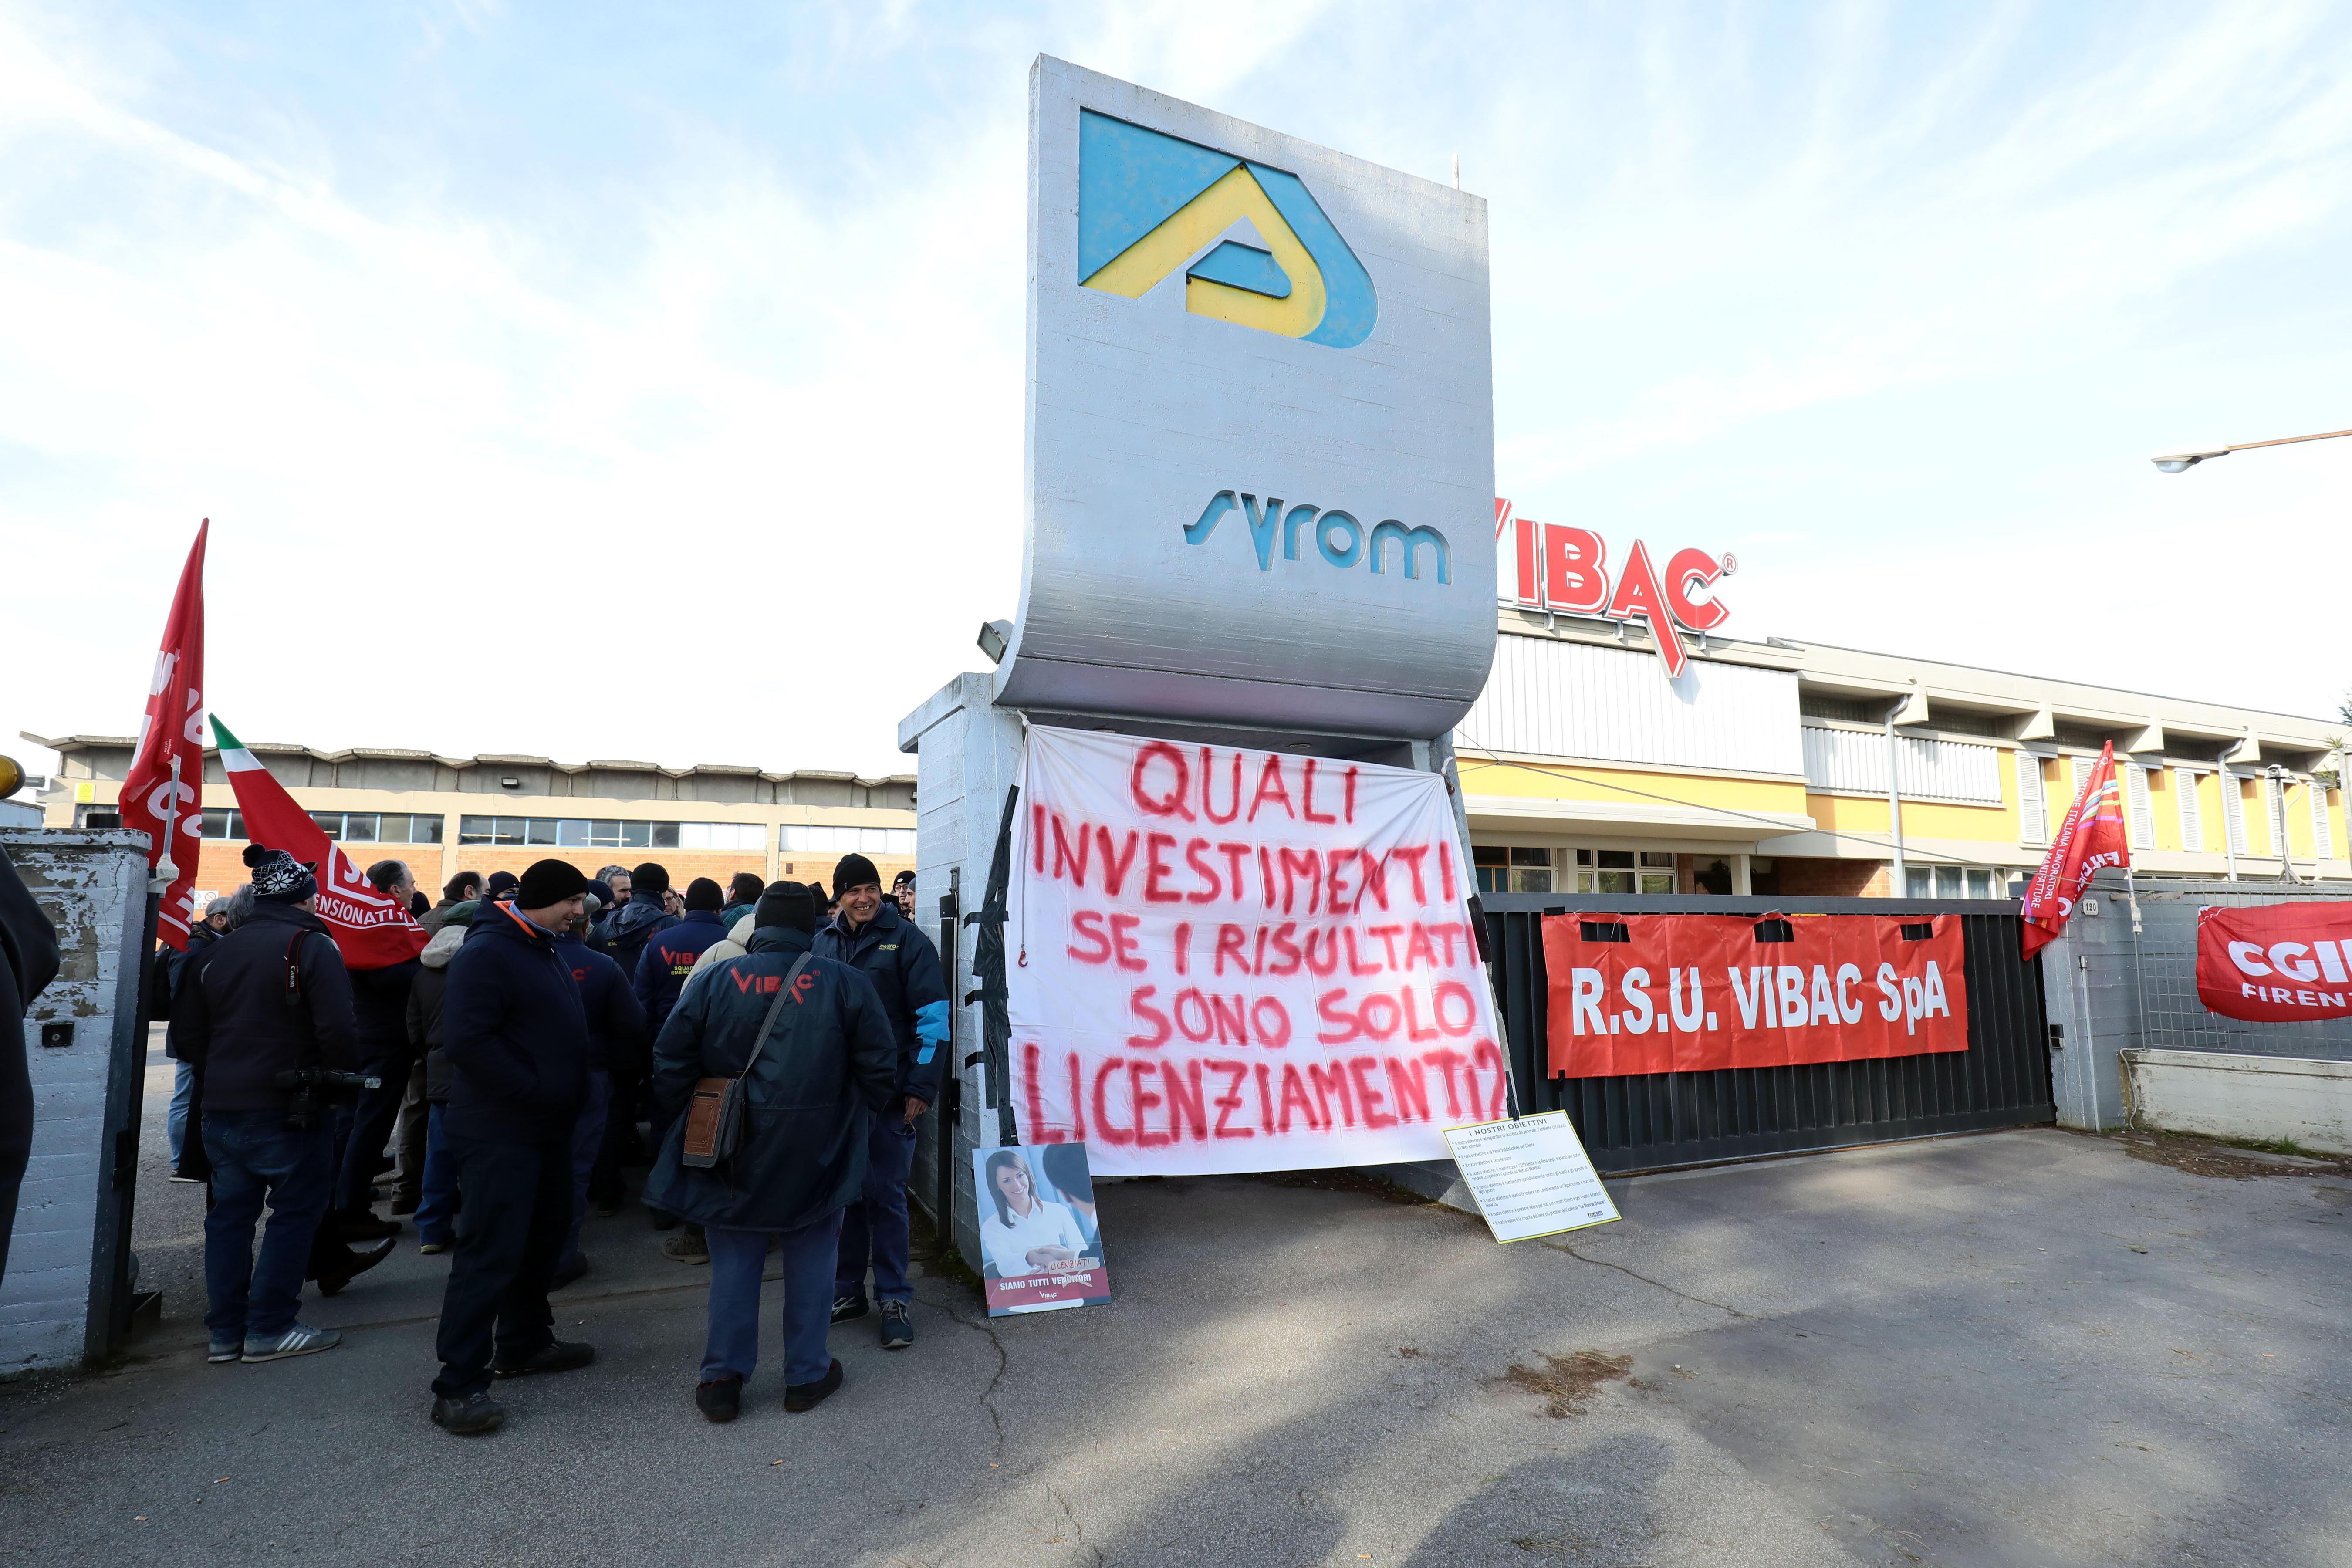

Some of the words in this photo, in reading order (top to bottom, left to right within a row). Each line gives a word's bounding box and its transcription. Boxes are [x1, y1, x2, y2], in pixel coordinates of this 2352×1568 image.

[1132, 741, 1358, 825] QUALI
[2059, 810, 2078, 847] ITALIANA
[1032, 801, 1456, 915] INVESTIMENTI
[2044, 849, 2065, 900] LAVORATORI
[314, 893, 392, 925] ENSIONATI
[2086, 902, 2096, 911] 120
[660, 945, 703, 966] VIB
[1069, 910, 1147, 974] SE
[1173, 921, 1191, 976] I
[1213, 920, 1478, 977] RISULTATI
[1572, 967, 1718, 1036] R.S.U.
[1728, 963, 1863, 1030] VIBAC
[1877, 960, 1950, 1036] SpA
[2242, 982, 2352, 1007] FIREN
[1128, 984, 1291, 1048] SONO
[1317, 980, 1477, 1044] SOLO
[1475, 1125, 1505, 1135] NOSTRI
[1508, 1119, 1547, 1129] OBIETTIVI
[1051, 1258, 1090, 1270] LICENZIATI
[1000, 1281, 1025, 1291] SIAMO
[1028, 1278, 1049, 1288] TUTTI
[1039, 1291, 1057, 1299] VIBAC
